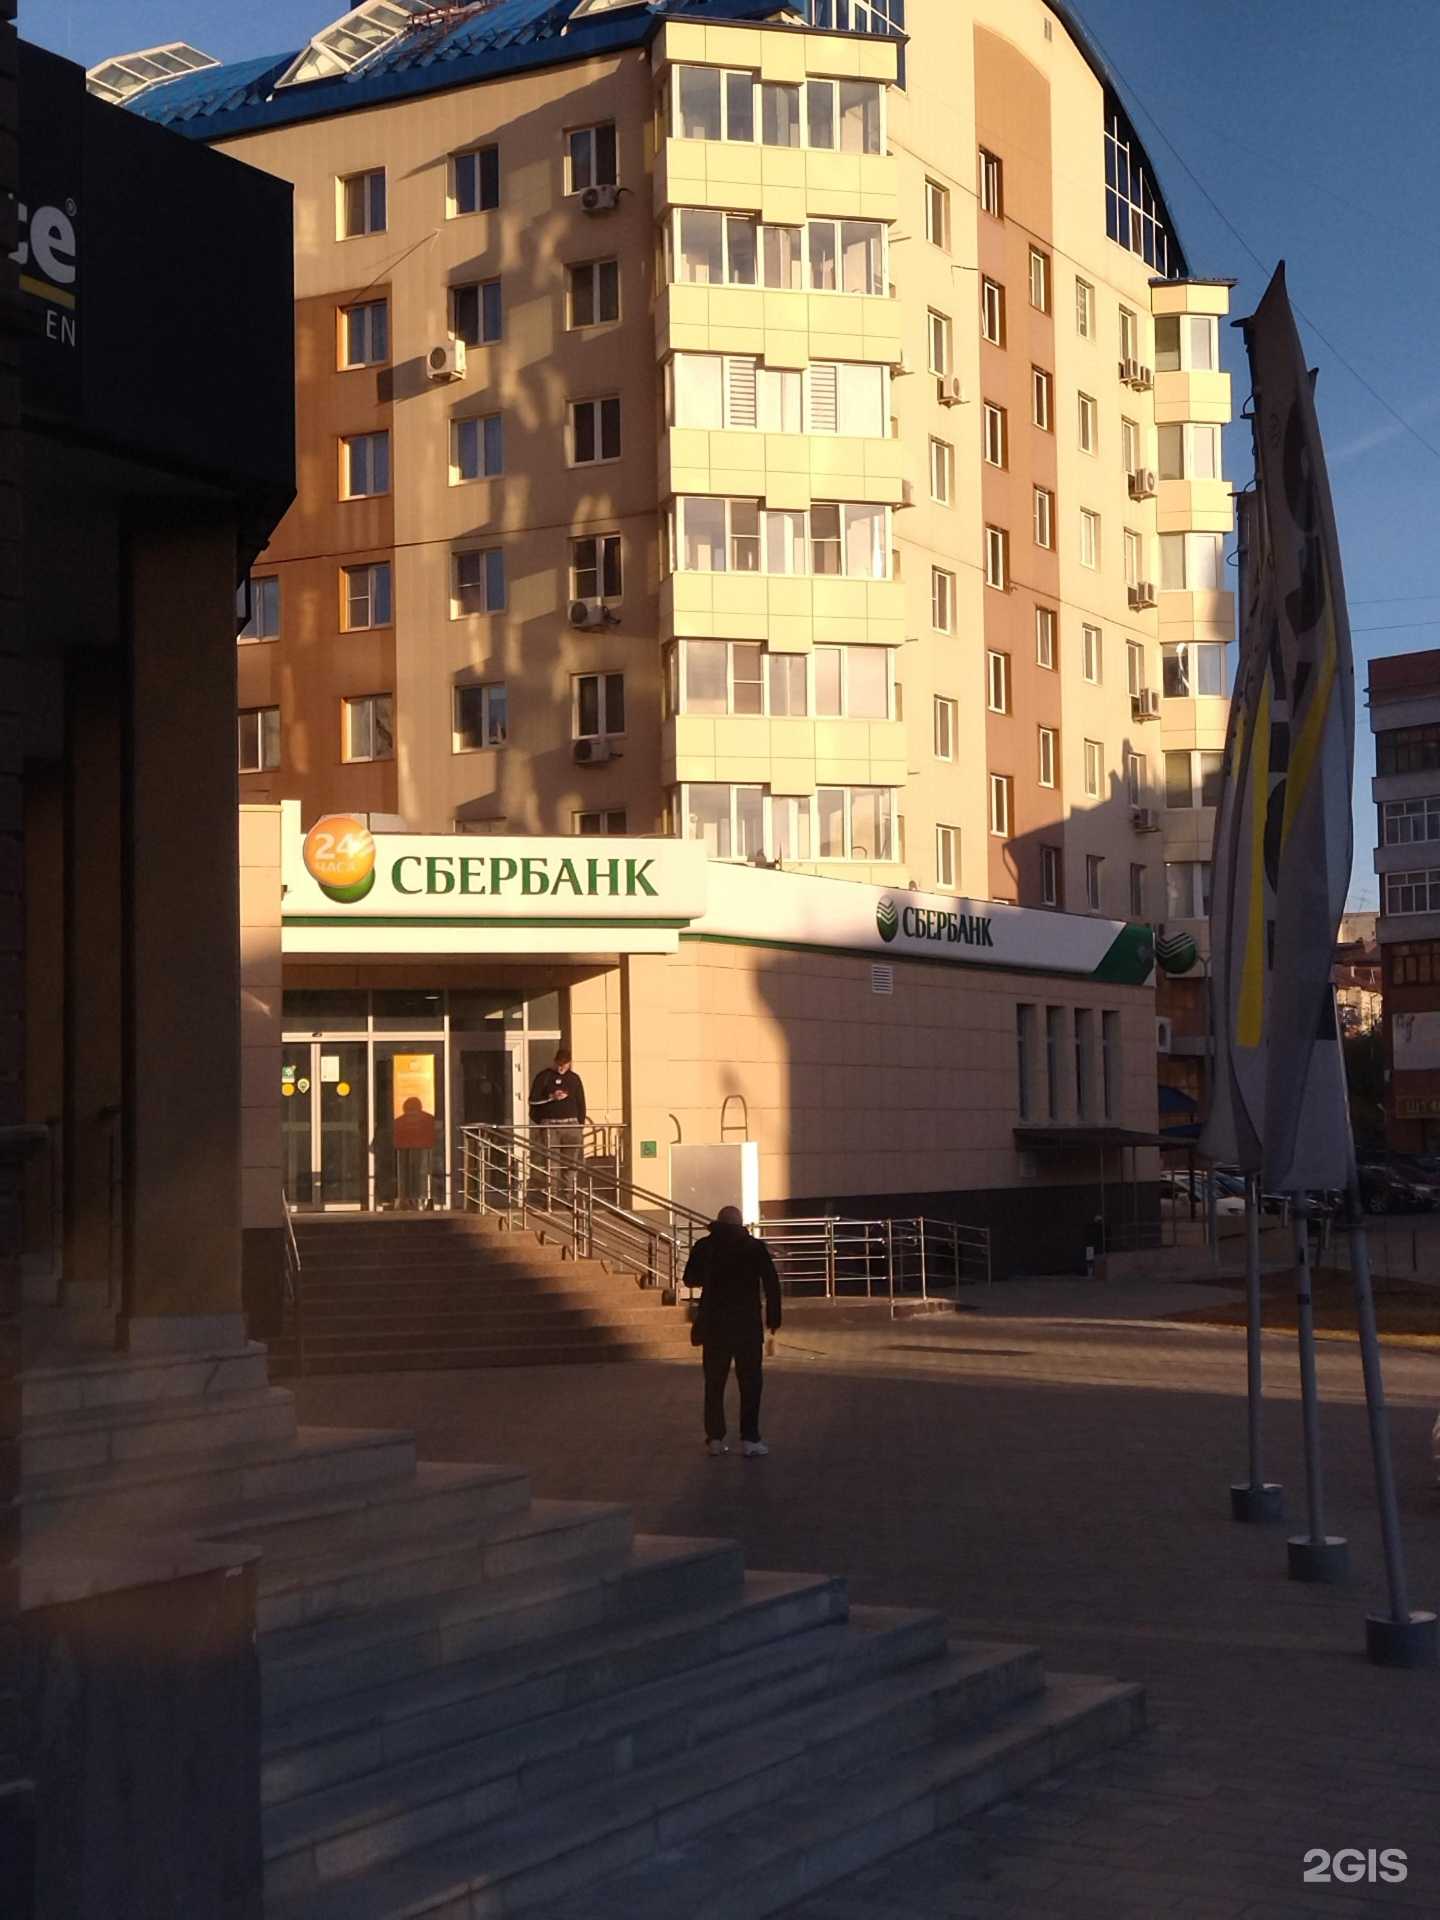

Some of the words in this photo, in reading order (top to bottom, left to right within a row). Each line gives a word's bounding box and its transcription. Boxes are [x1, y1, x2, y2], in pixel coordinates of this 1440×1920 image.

[315, 832, 358, 860] 24
[391, 855, 659, 897] СБЕРБАНК
[902, 906, 994, 947] СБЕРБАНК
